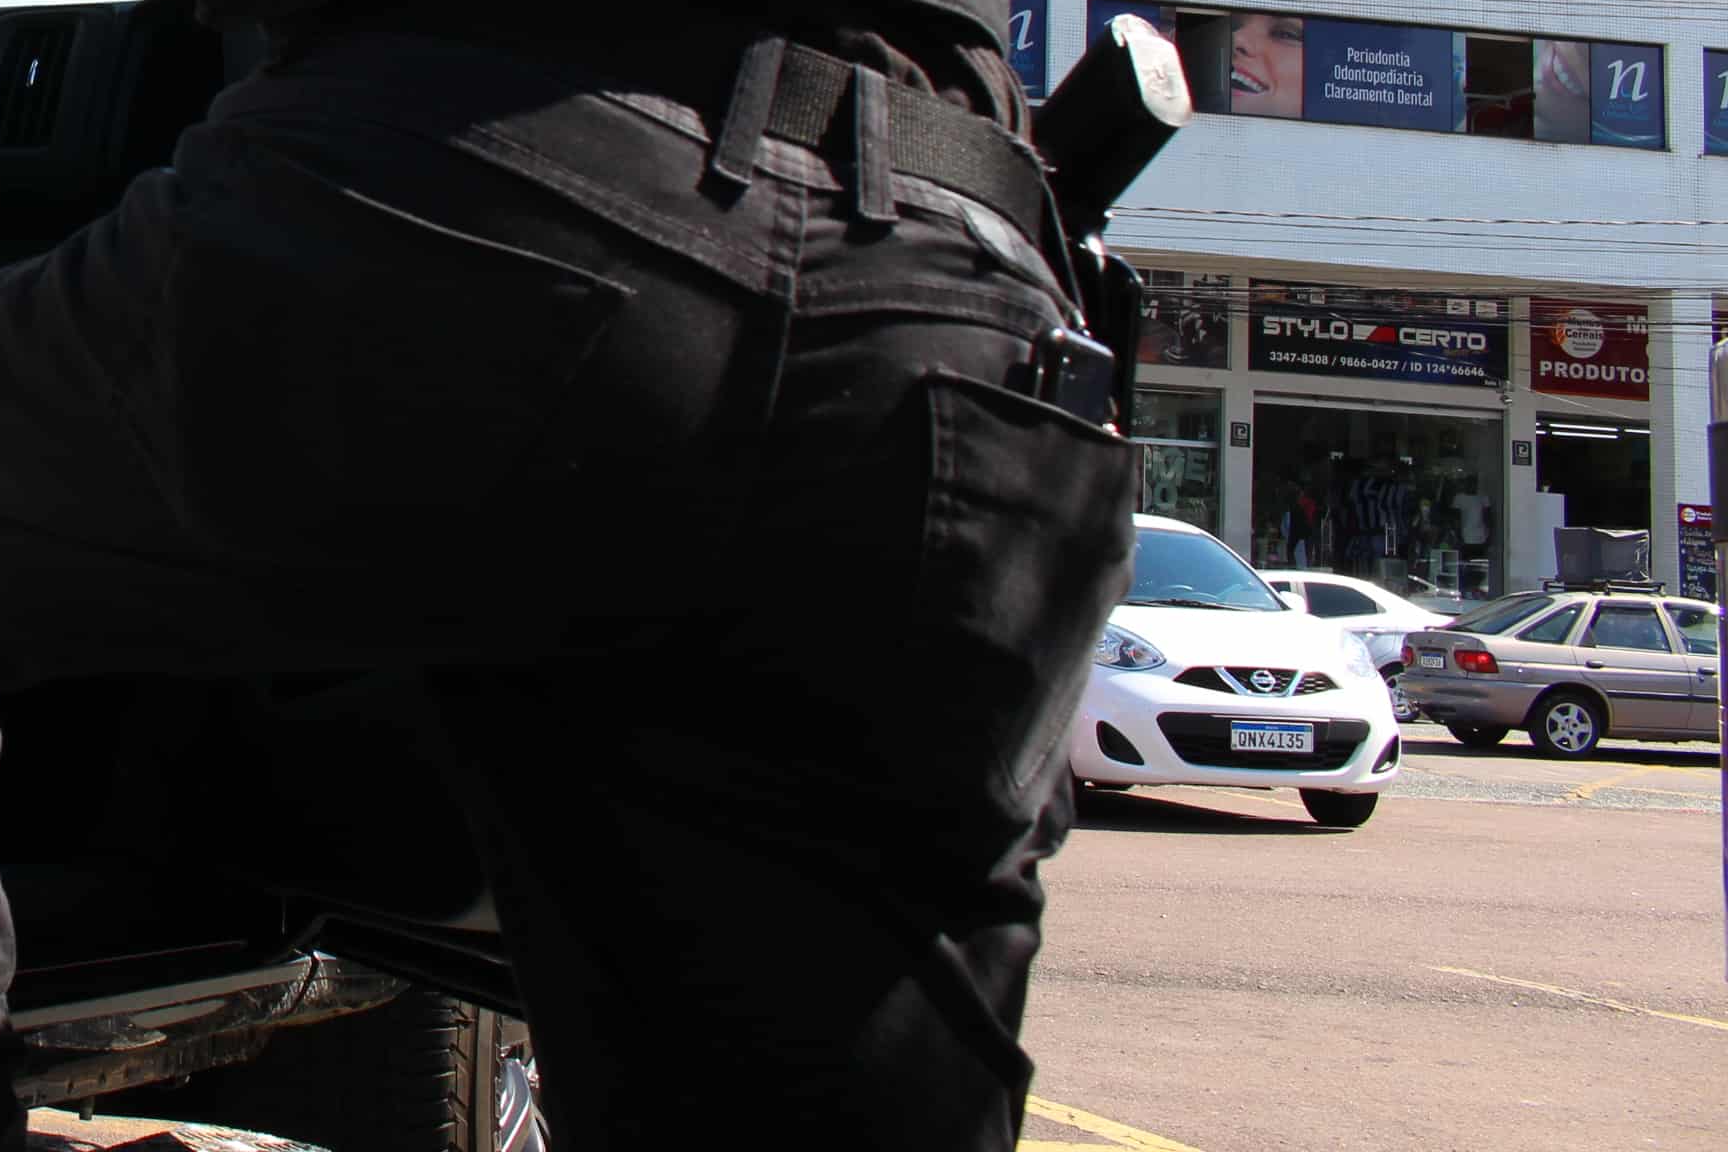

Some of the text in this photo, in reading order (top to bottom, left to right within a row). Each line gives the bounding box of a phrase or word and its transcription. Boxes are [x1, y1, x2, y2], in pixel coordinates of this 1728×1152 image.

[1347, 47, 1410, 67] Periodontia
[1334, 64, 1424, 87] Odontopediatria
[1324, 83, 1433, 106] Clareamento Dental
[1263, 316, 1487, 351] STYLO CERTO
[1269, 351, 1328, 366] 3347-8308
[1410, 362, 1422, 372] ID
[1539, 360, 1650, 383] PRODUTO
